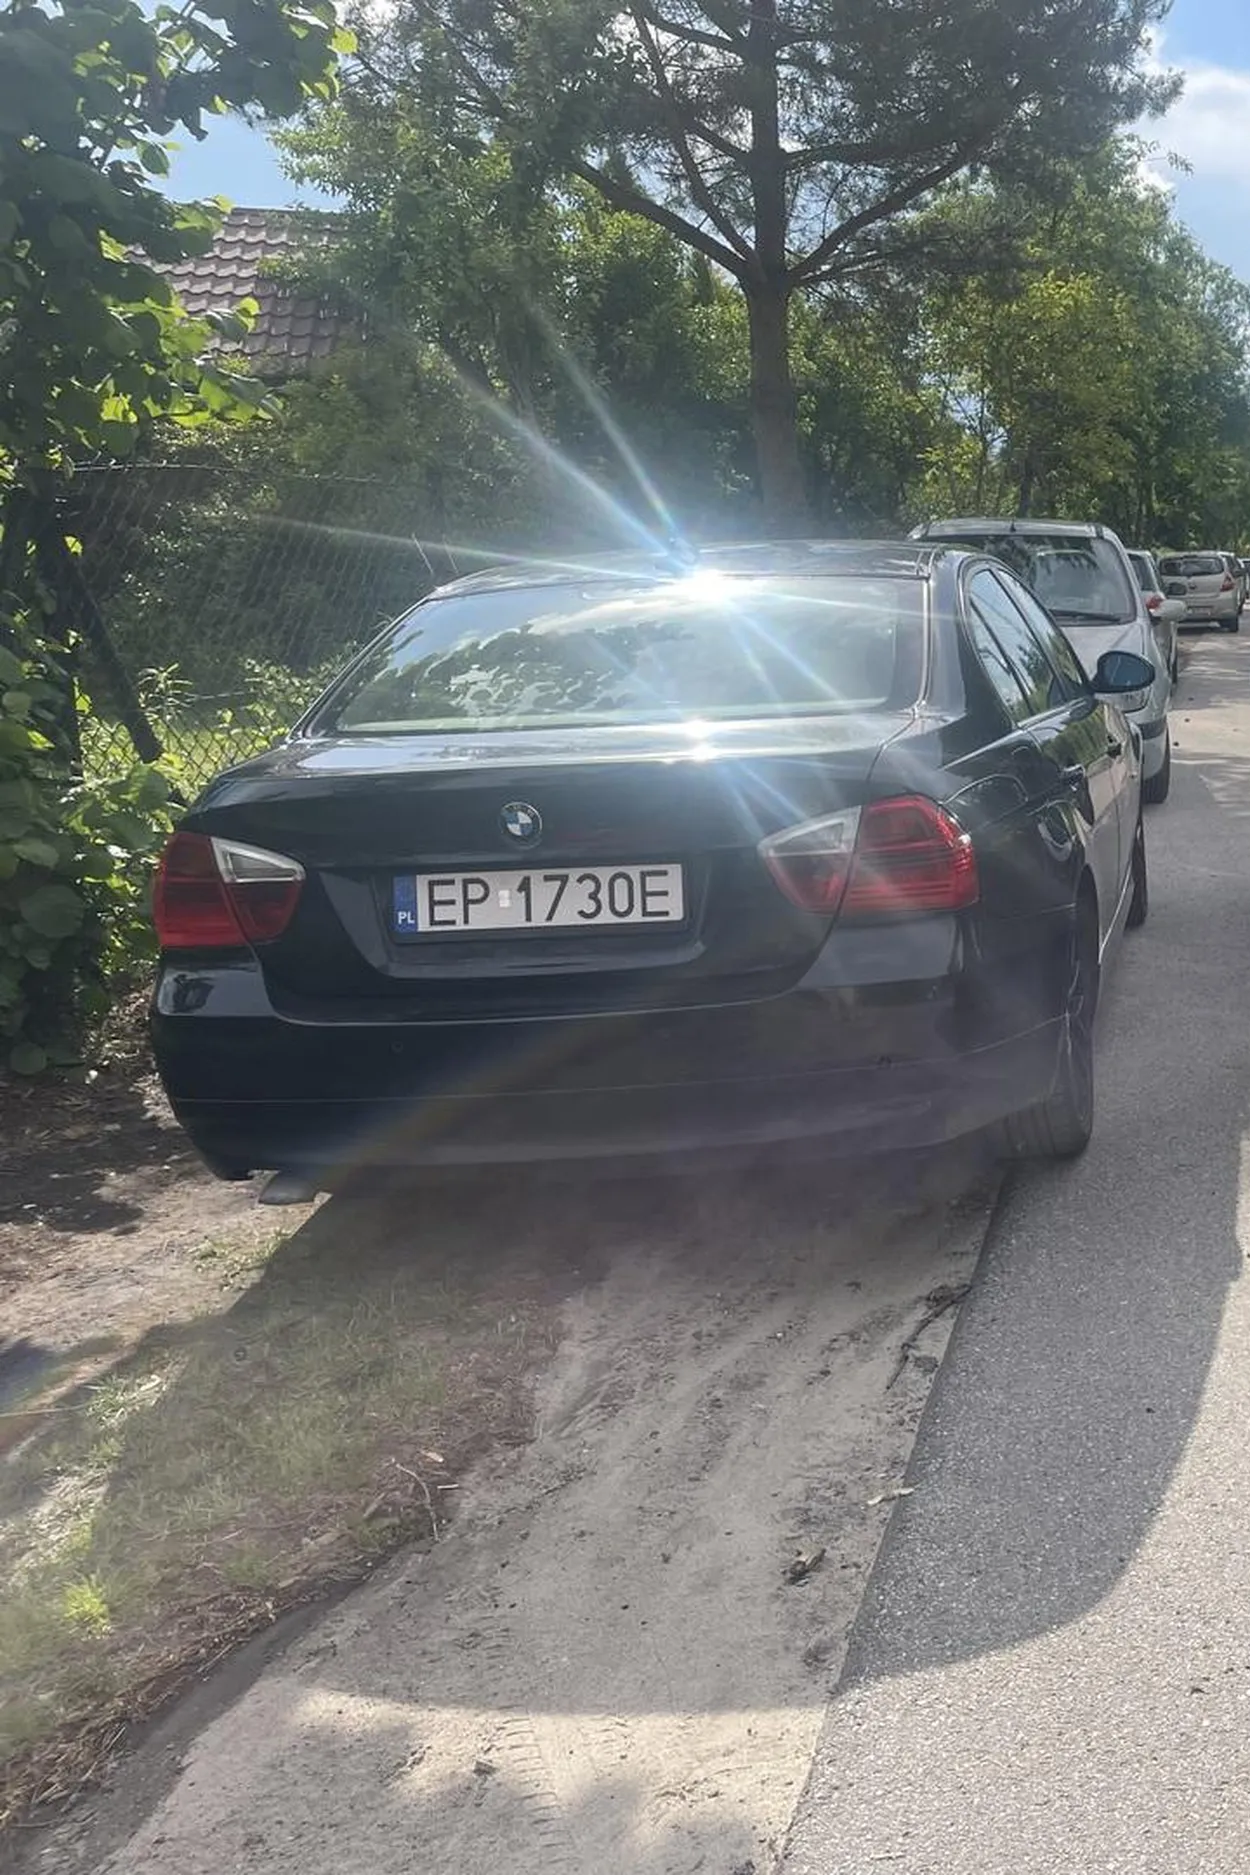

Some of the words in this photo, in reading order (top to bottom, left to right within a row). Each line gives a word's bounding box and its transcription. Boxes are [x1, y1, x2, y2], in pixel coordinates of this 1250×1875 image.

[428, 878, 490, 926] EP
[517, 869, 669, 922] 1730E
[398, 911, 415, 924] PL
